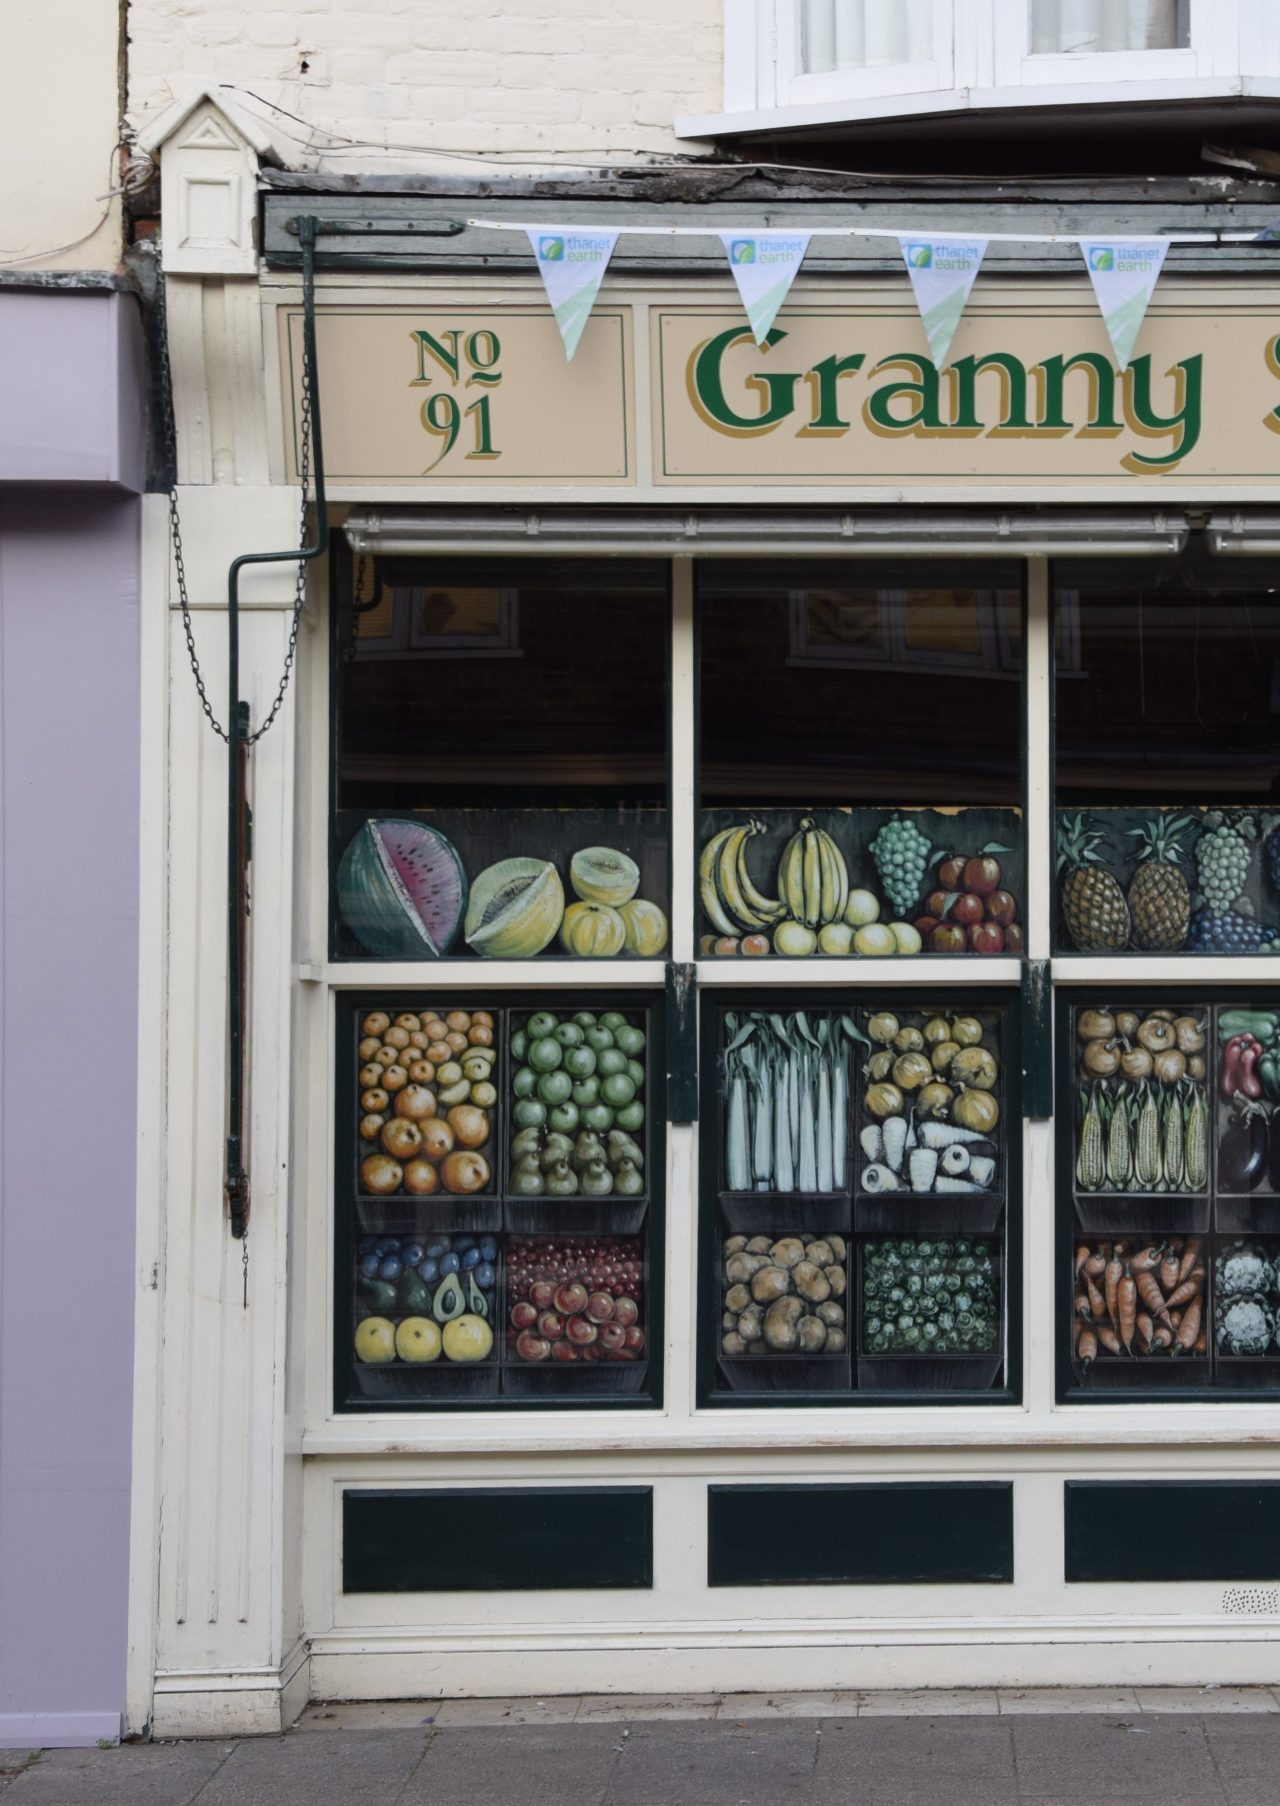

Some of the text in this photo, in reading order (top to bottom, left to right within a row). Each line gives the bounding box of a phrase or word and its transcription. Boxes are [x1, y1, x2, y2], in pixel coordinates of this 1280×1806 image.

[567, 236, 612, 251] thanet
[759, 239, 803, 253] thanet
[567, 250, 602, 262] earth
[759, 252, 794, 264] earth
[934, 244, 979, 260] thanet
[1118, 247, 1161, 261] thanet
[934, 258, 970, 270] earth
[1118, 260, 1153, 272] earth
[685, 325, 1203, 476] Granny
[419, 392, 503, 476] 91
